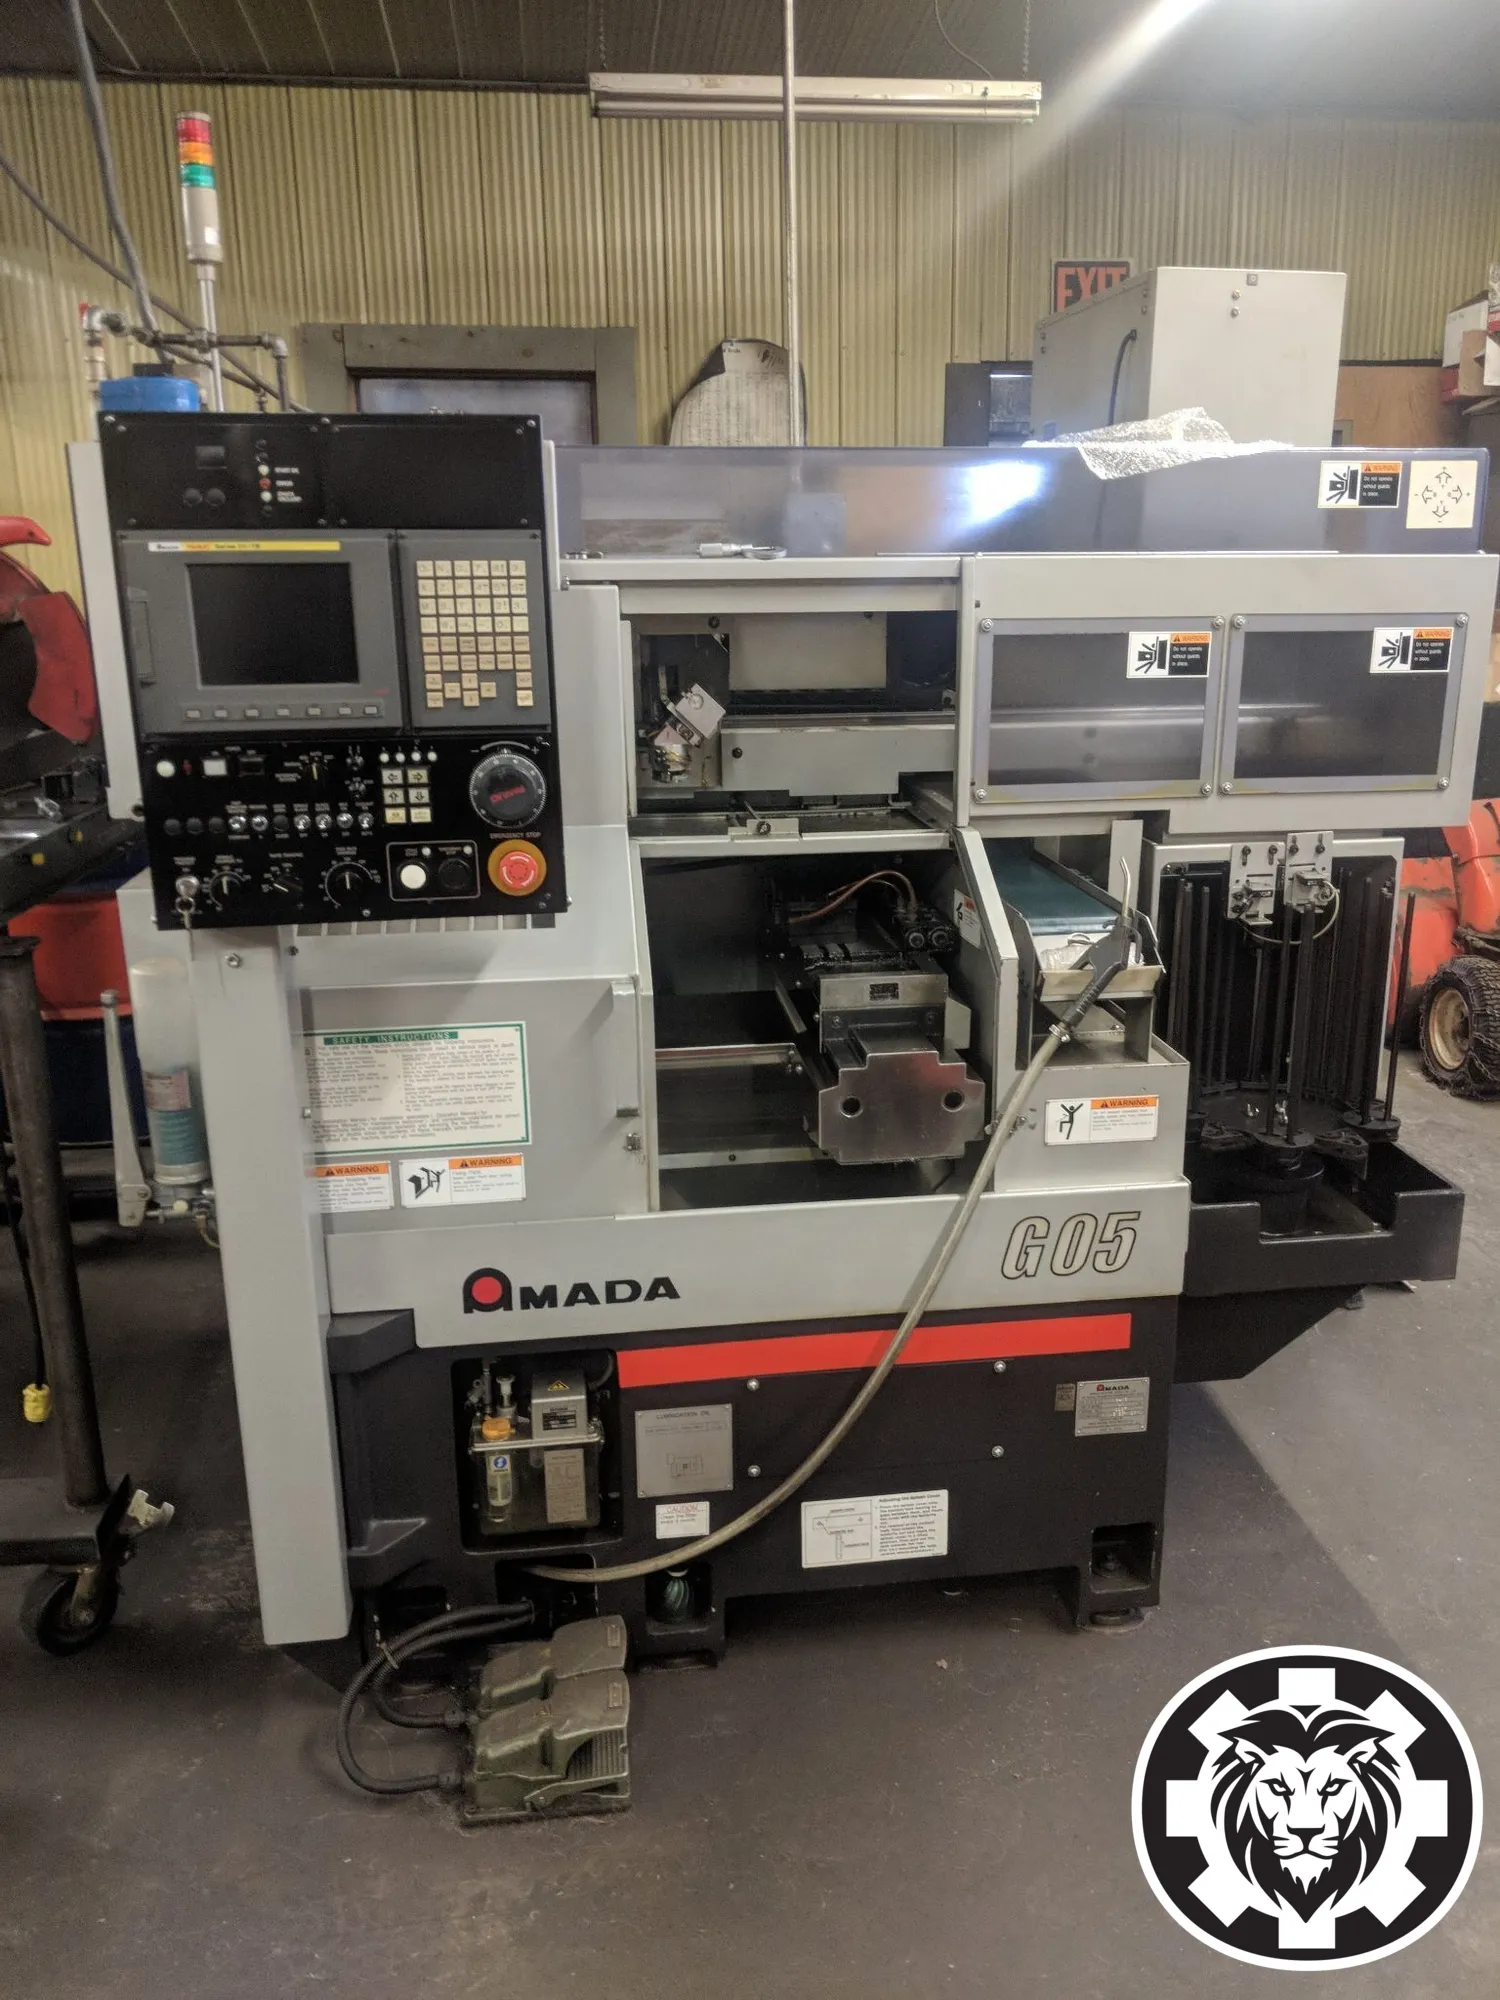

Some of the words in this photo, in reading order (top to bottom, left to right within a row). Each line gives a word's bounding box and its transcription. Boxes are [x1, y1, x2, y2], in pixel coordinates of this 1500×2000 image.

[332, 1036, 370, 1045] SAFETY
[377, 1031, 451, 1043] INSTRUCTIONS
[1109, 1098, 1149, 1108] WARNING
[469, 1156, 513, 1167] WARNING
[335, 1165, 380, 1175] WARNING
[462, 1266, 681, 1315] AMADA
[1096, 1383, 1130, 1393] AMADA
[656, 1411, 698, 1420] LUBRICATION
[666, 1503, 699, 1513] CAUTION
